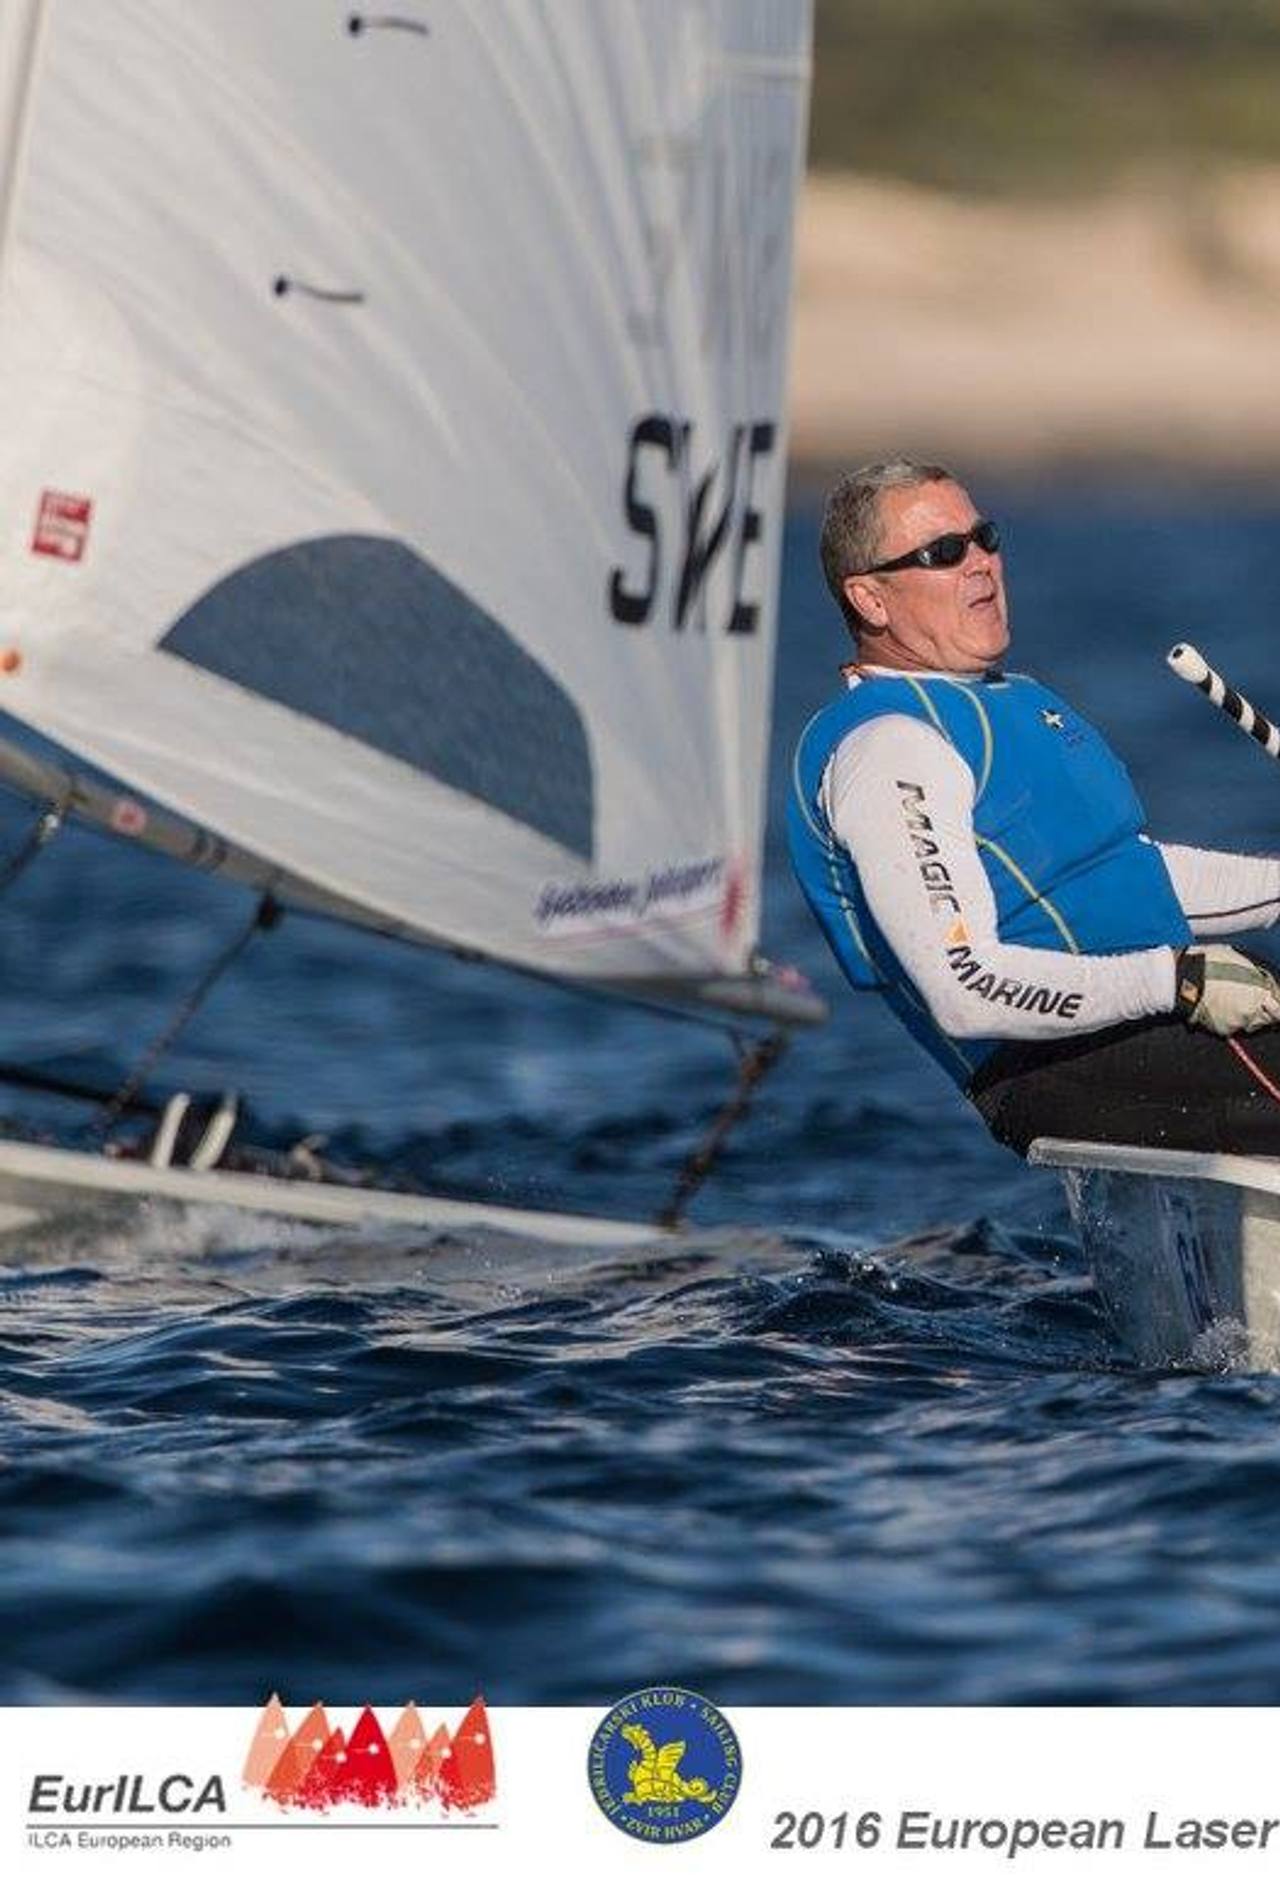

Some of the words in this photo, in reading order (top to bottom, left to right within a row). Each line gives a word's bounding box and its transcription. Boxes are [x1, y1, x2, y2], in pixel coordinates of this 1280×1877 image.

[609, 415, 777, 634] SWE
[896, 780, 962, 914] MAGIC
[946, 945, 1084, 1018] MARINE
